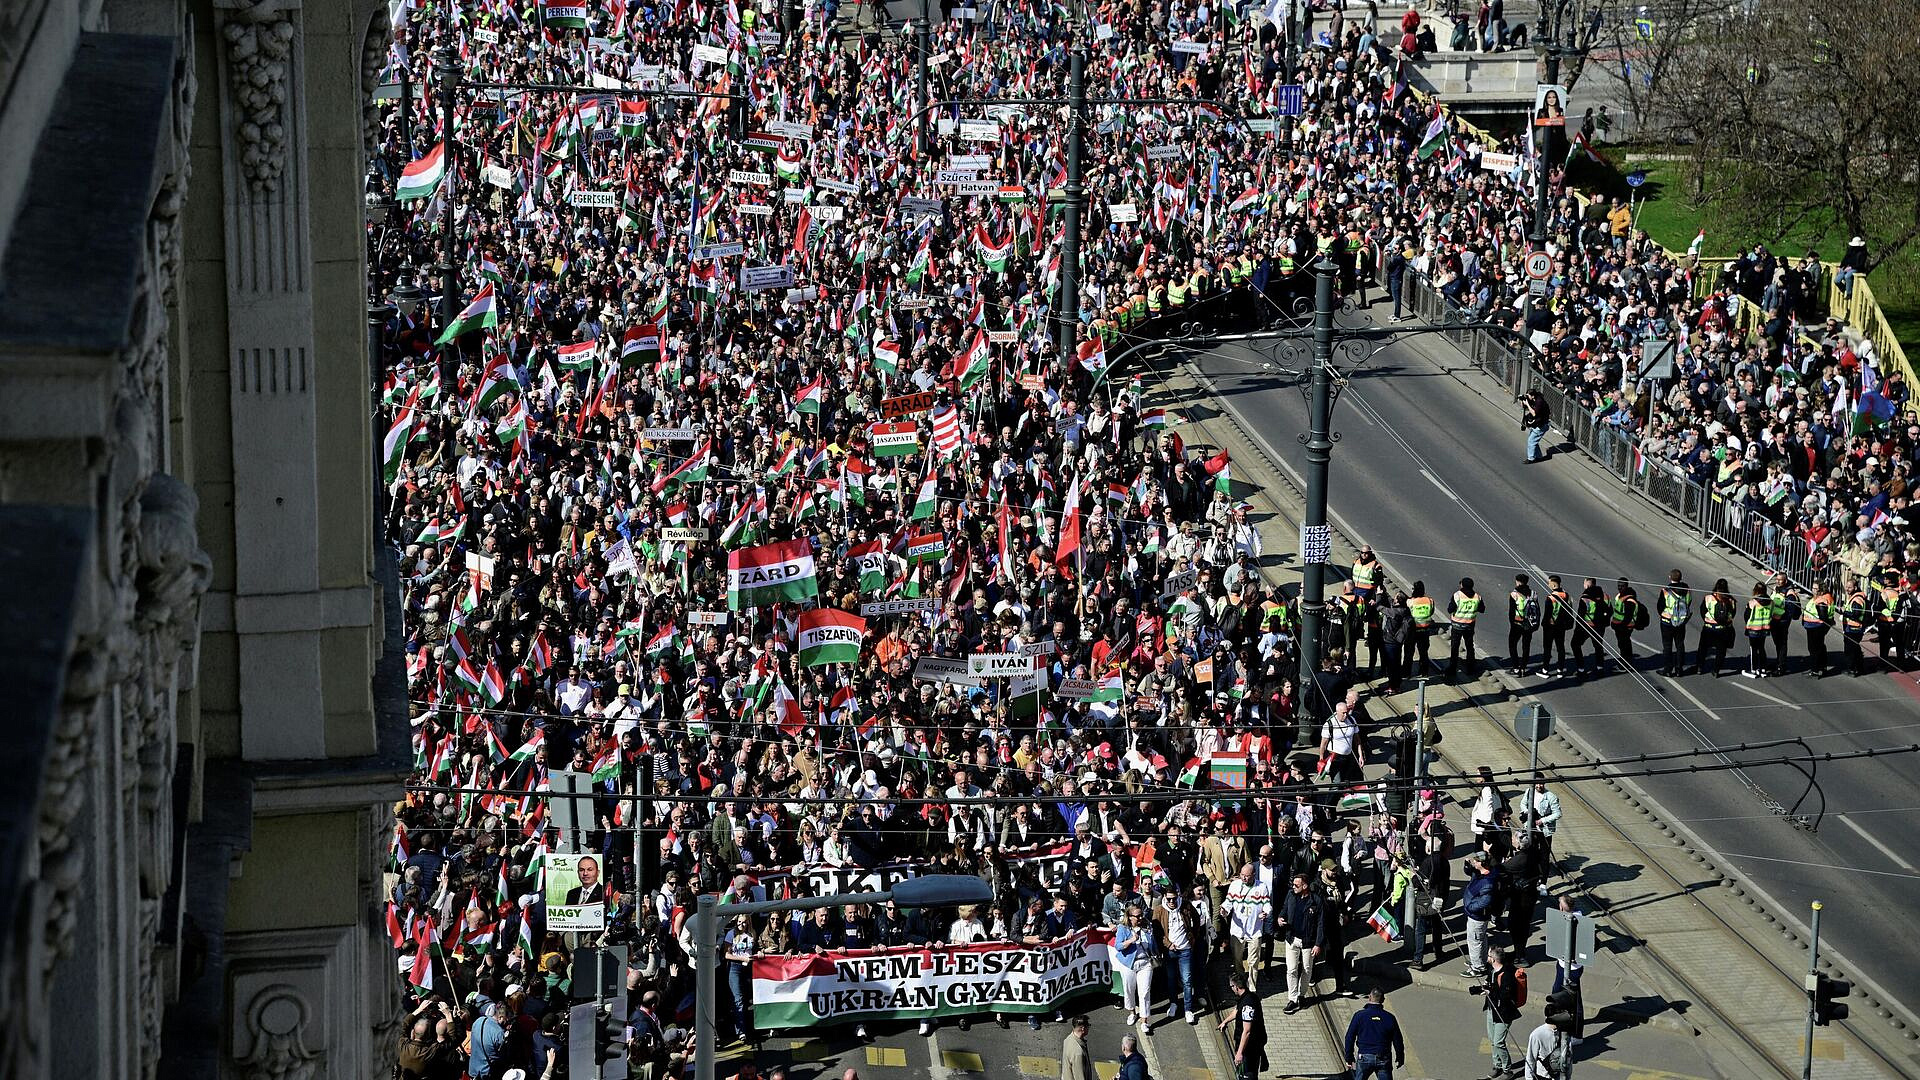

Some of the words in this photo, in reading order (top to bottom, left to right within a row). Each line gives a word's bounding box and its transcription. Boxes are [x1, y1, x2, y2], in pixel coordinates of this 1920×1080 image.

[548, 7, 579, 17] PERENYE
[1482, 156, 1514, 167] KISPEST
[961, 183, 994, 192] Hatvan
[573, 194, 614, 205] EGERCSEHI
[1532, 260, 1546, 271] 40
[990, 332, 1016, 341] CSORNA
[1166, 573, 1193, 593] TASS
[868, 600, 936, 613] CSEPREG
[700, 612, 716, 622] TÉT
[1024, 643, 1050, 657] SZIL
[991, 657, 1028, 669] IVÁN
[548, 908, 582, 918] NAGY
[837, 955, 922, 983] NEM
[933, 937, 1088, 978] LESZÜNK
[809, 980, 940, 1017] UKRÁN
[946, 959, 1112, 1005] GYARMAT!
